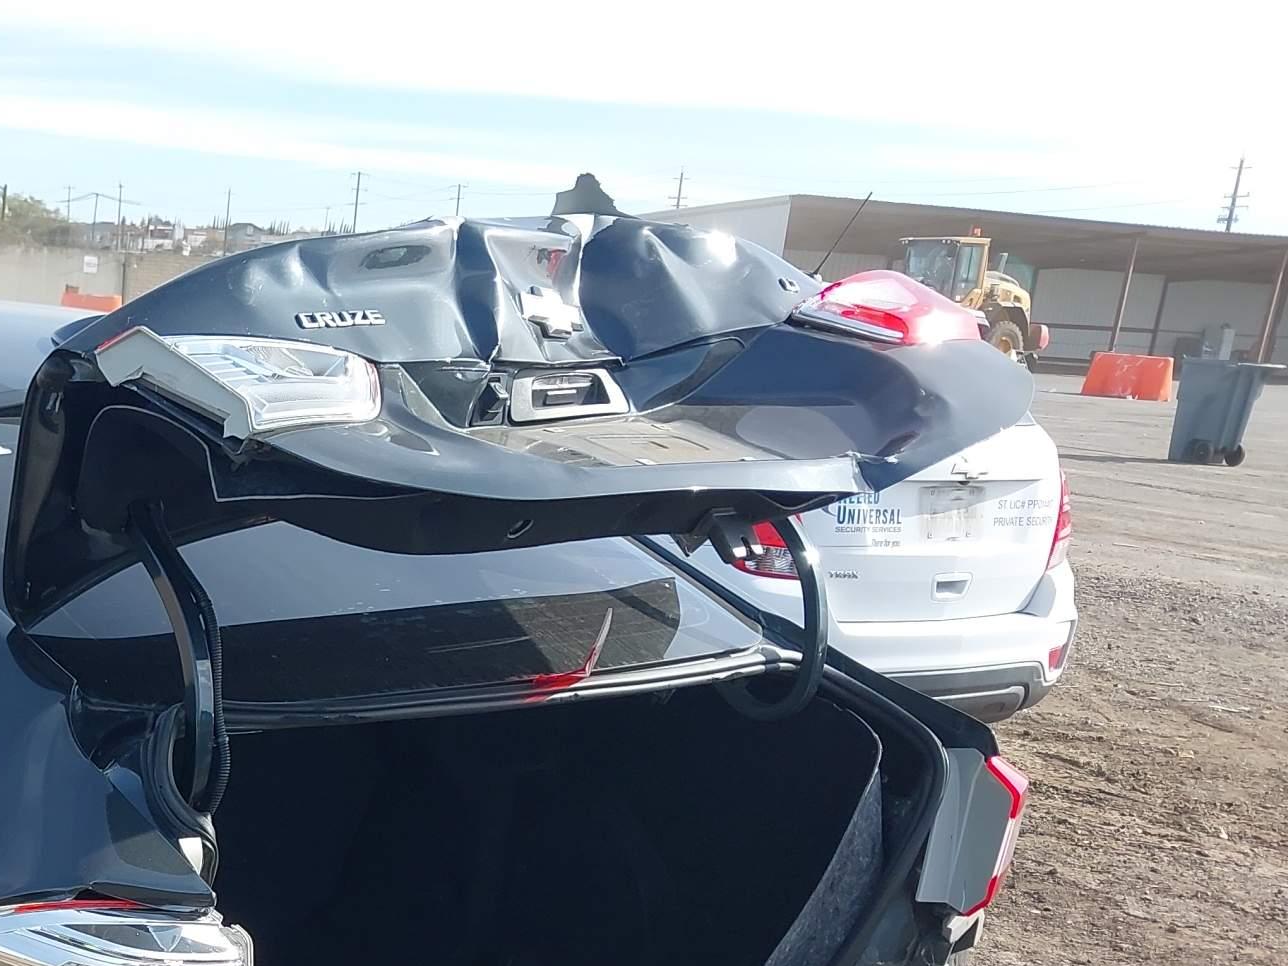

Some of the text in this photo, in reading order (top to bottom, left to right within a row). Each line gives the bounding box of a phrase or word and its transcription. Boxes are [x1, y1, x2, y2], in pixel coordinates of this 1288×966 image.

[294, 309, 386, 330] CRUZE
[838, 491, 880, 505] LLIED
[837, 505, 902, 525] UNIVERSAL
[993, 516, 1025, 527] PRIVATE
